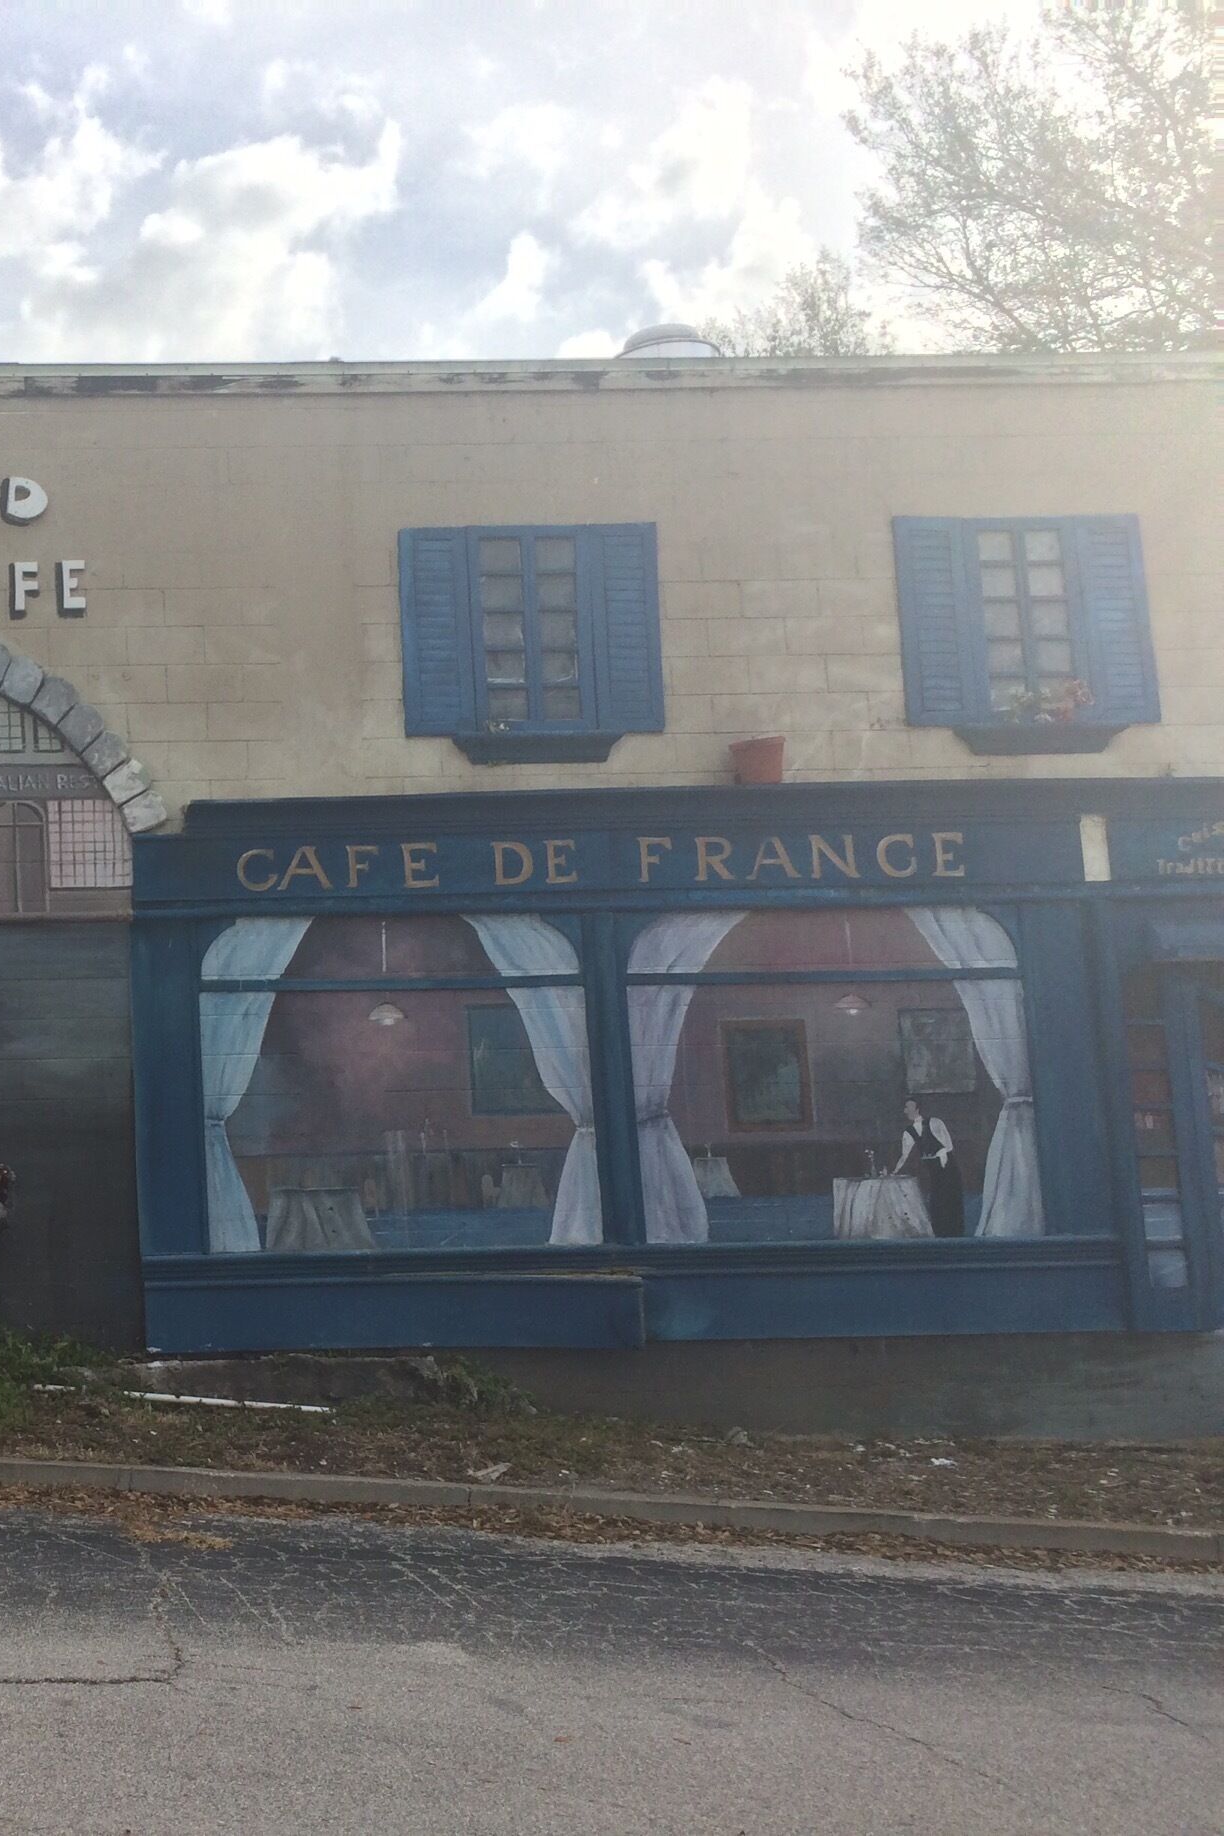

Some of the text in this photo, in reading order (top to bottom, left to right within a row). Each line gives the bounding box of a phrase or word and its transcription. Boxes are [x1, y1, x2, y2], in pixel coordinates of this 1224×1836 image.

[236, 831, 965, 892] CAFE DE FRANCE
